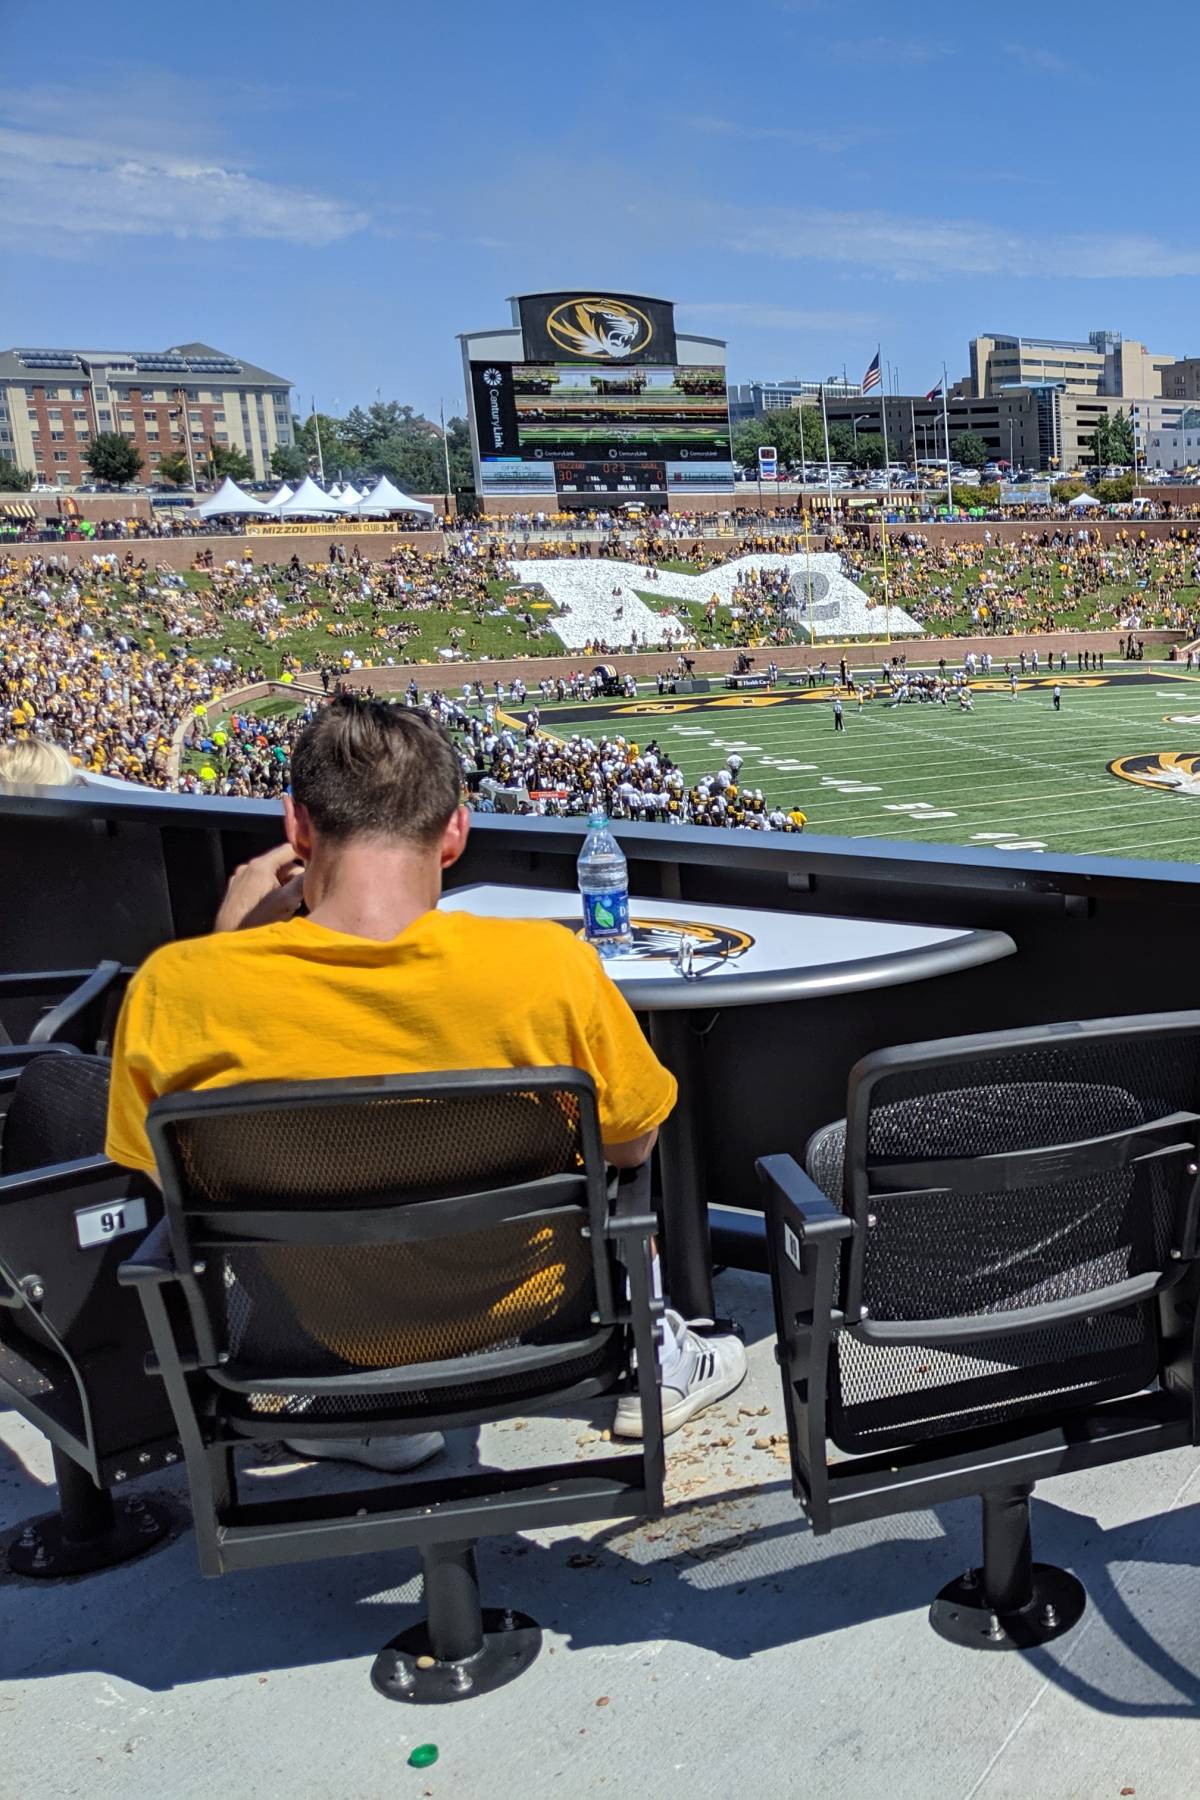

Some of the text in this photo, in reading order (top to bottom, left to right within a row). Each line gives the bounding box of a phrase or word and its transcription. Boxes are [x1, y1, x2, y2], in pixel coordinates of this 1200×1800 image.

[490, 389, 504, 448] CenturyLink
[262, 526, 308, 535] MIZZOU
[363, 523, 380, 532] CLUB
[383, 523, 395, 533] M
[100, 1210, 126, 1233] 91
